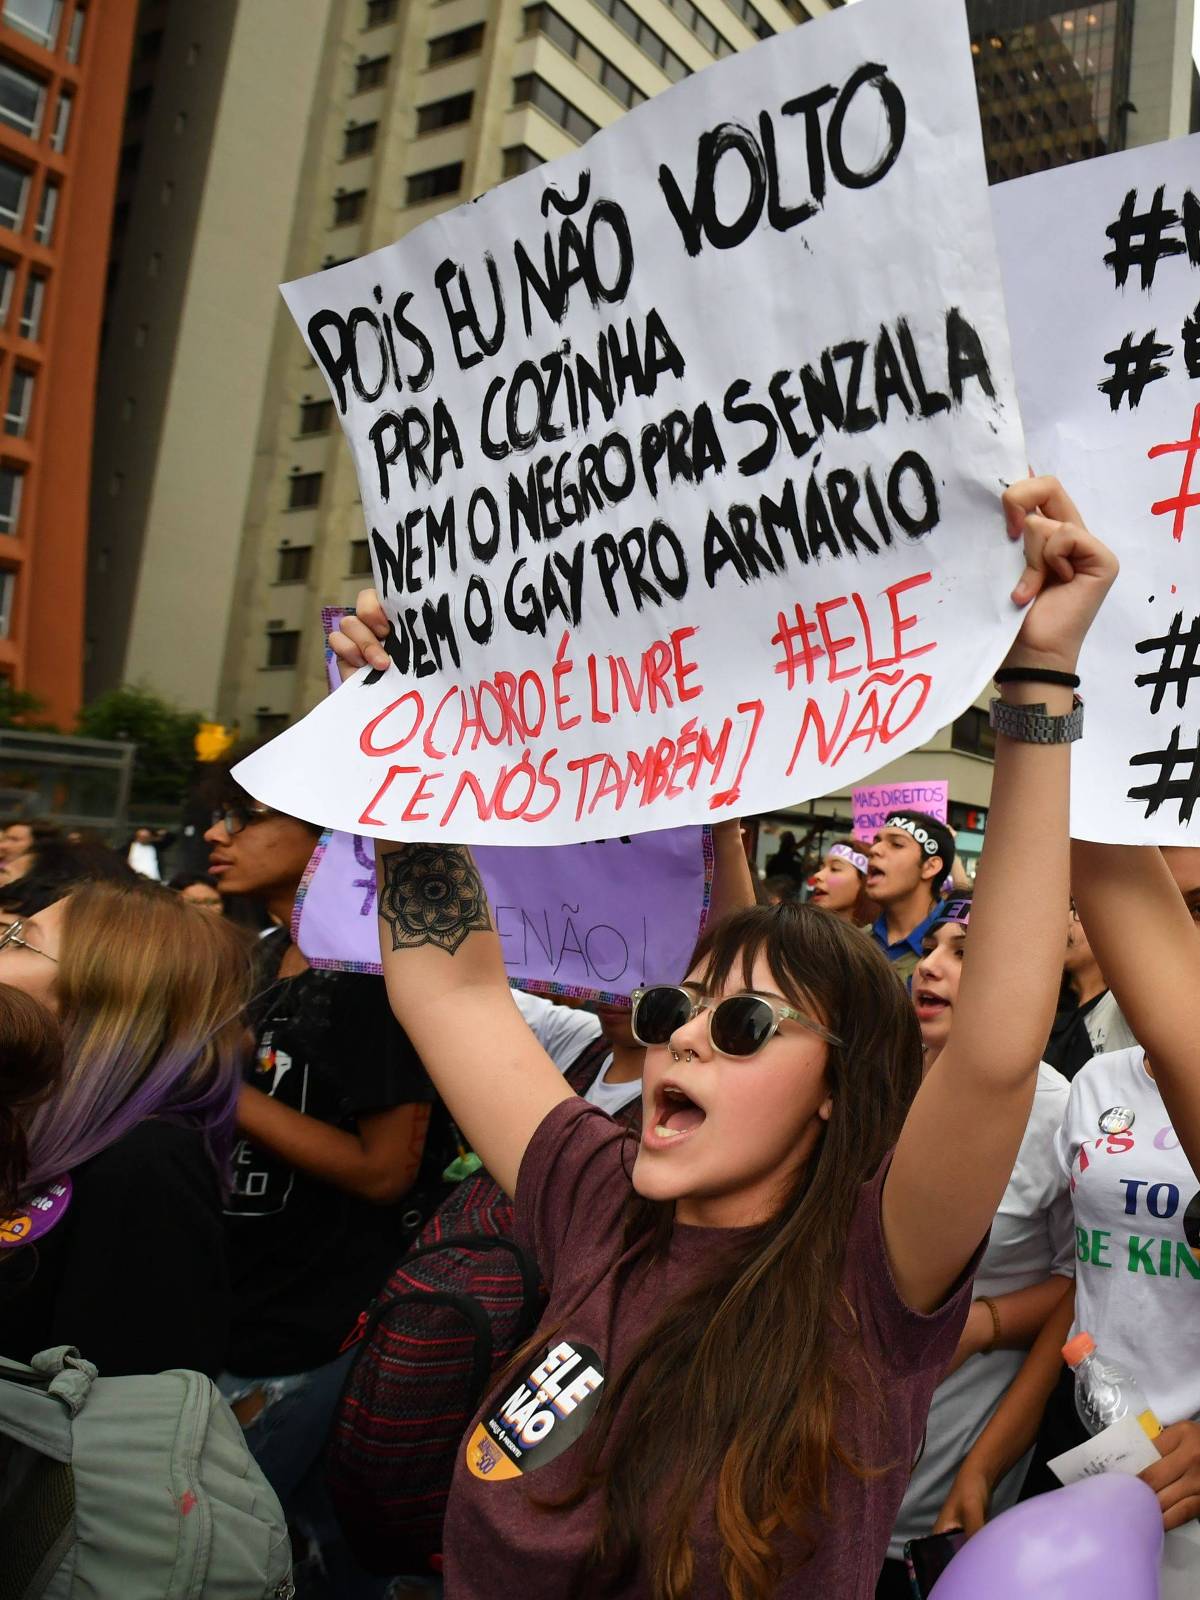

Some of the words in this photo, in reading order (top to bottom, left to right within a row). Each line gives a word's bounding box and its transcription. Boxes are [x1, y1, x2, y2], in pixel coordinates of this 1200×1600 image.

[435, 250, 506, 370] EU
[514, 168, 634, 338] NÃO
[658, 62, 906, 256] VOLTO
[369, 397, 464, 503] PRA
[371, 496, 459, 600] NEM
[467, 487, 500, 565] O
[508, 431, 636, 553] NEGRO
[640, 401, 727, 502] PRA
[723, 306, 997, 478] SENZALA
[464, 574, 494, 645] O
[504, 540, 586, 637] GAY
[591, 517, 689, 617] PRO
[703, 450, 940, 589] ARMÁRIO
[771, 571, 938, 691] #ELE
[359, 689, 424, 757] O
[423, 670, 546, 760] CHORO
[552, 629, 582, 735] É
[587, 625, 705, 723] LIVRE
[785, 668, 932, 777] NÃO
[440, 747, 563, 827] NÓS
[881, 787, 944, 807] DIREITOS
[1075, 1224, 1112, 1268] BE
[1119, 1178, 1180, 1219] TO
[497, 1383, 556, 1449] NÃO
[529, 1341, 605, 1420] ELE
